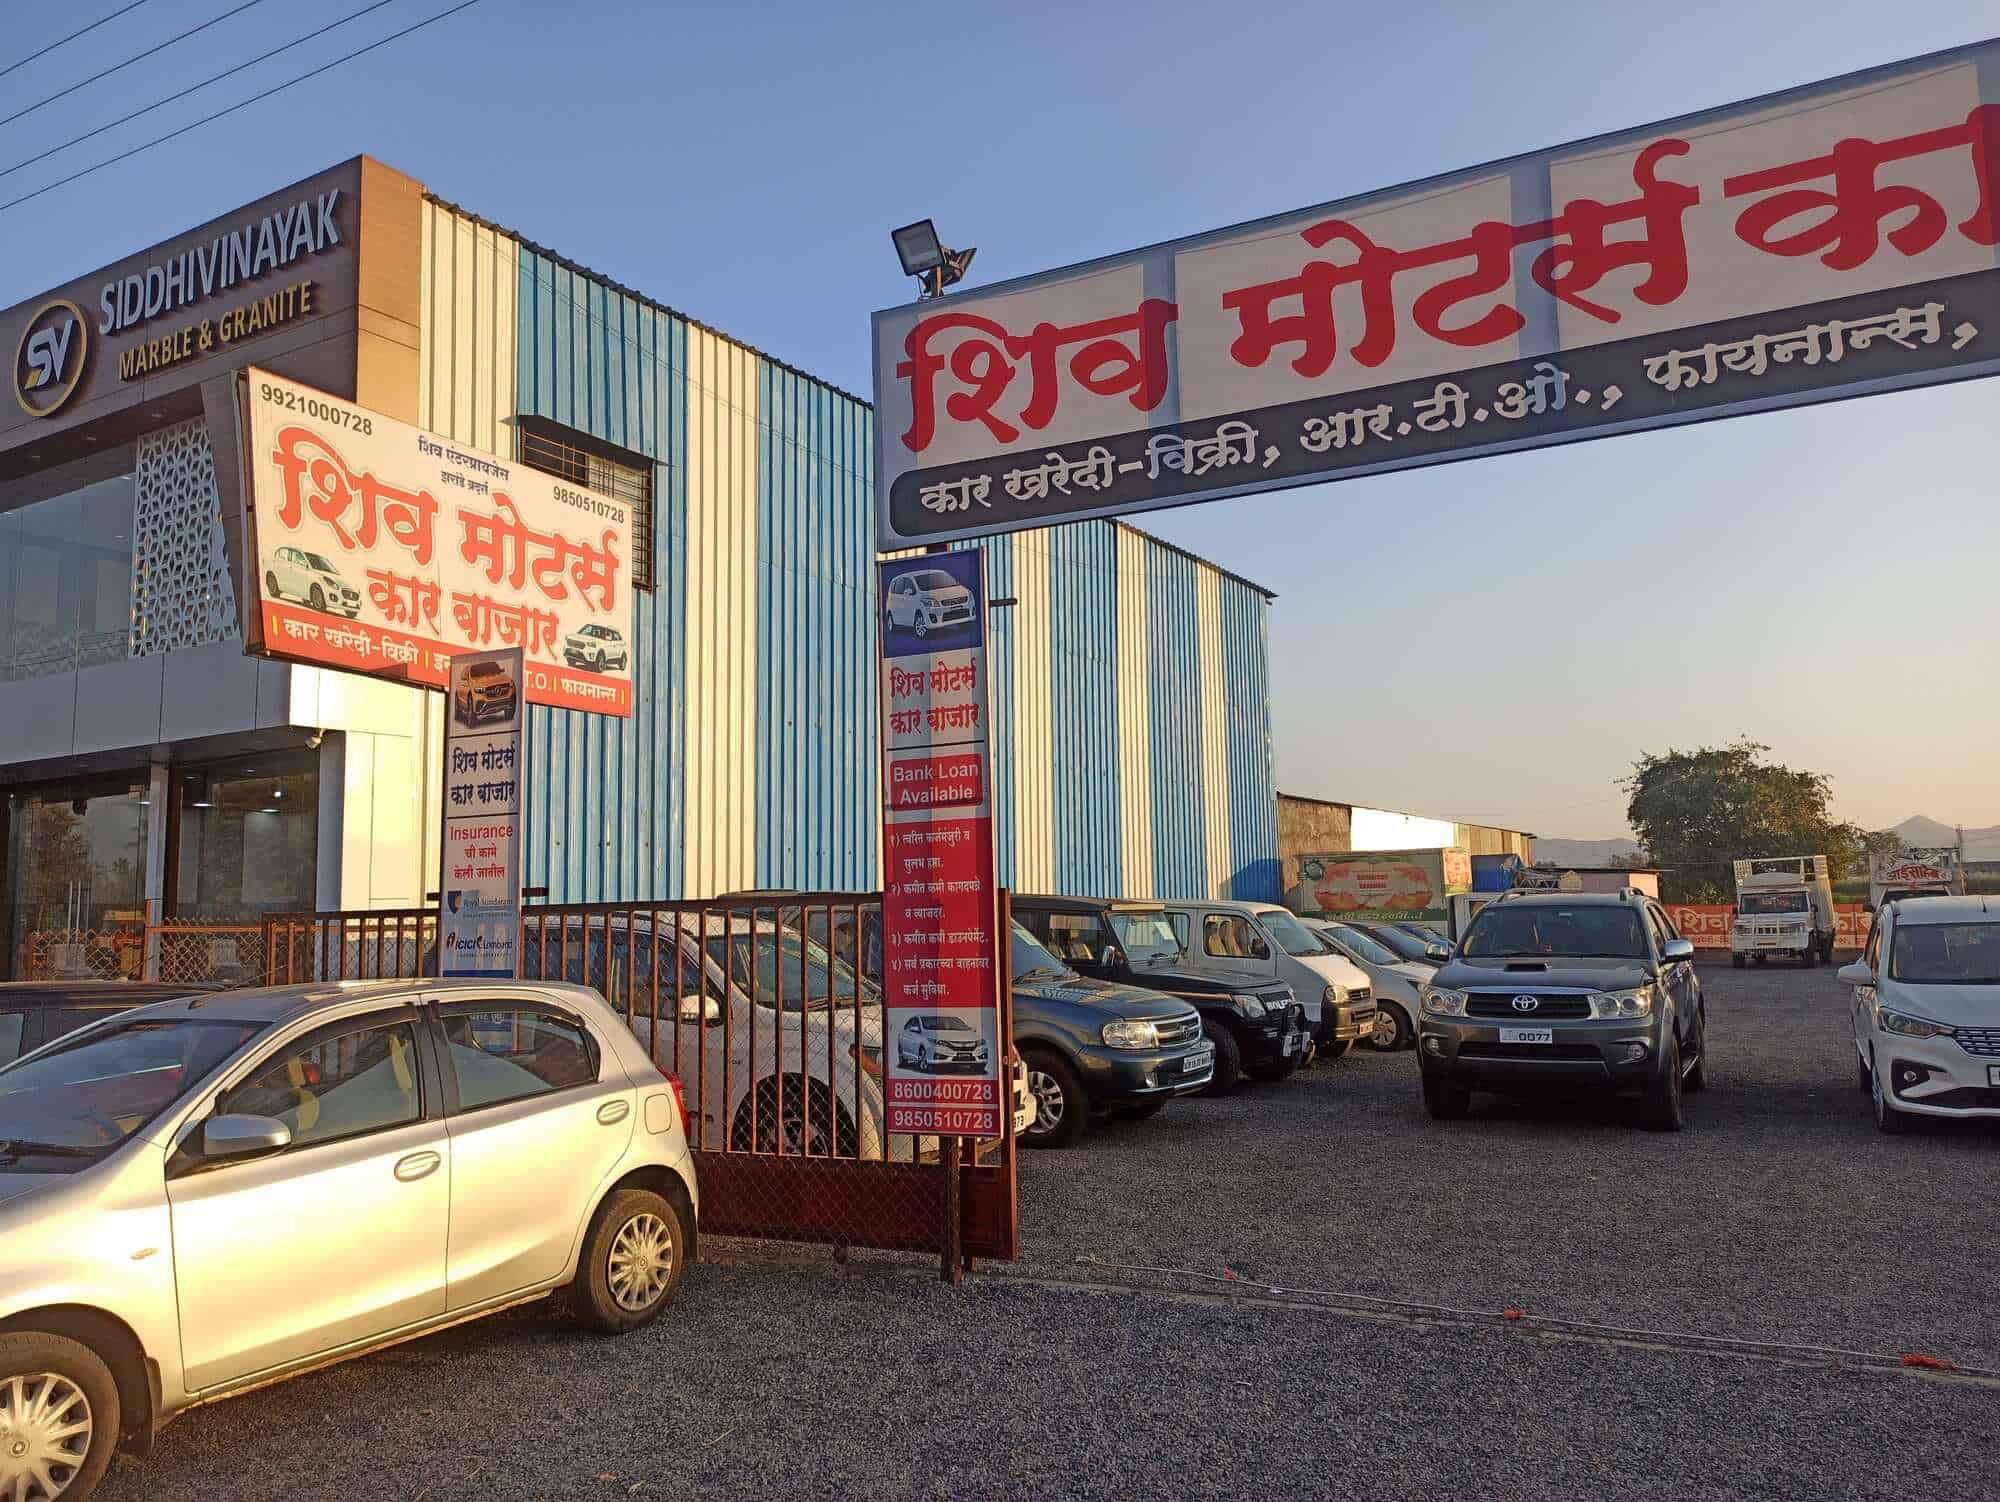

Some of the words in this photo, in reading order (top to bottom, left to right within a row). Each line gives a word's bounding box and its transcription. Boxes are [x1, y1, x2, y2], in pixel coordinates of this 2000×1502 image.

[99, 189, 341, 336] SIDDHIVINAYAK
[896, 299, 1178, 452] शिव
[1222, 139, 1700, 377] मोटर्स
[1723, 104, 2000, 271] का
[119, 326, 192, 381] MARBLE
[199, 319, 213, 351] &
[219, 280, 313, 343] GRANITE
[261, 384, 373, 436] 9921000728
[417, 436, 443, 460] शिव
[552, 486, 624, 524] 9850510728
[920, 474, 992, 513] कार
[273, 427, 438, 565] शिव
[457, 492, 619, 611] मोटर्स
[366, 568, 440, 635] कार
[452, 591, 559, 661] बाजार
[283, 618, 320, 648] कार
[889, 667, 925, 698] शिव
[930, 657, 977, 693] मोटर्स
[889, 709, 921, 734] कार
[927, 703, 980, 731] बाजार
[452, 747, 478, 774] शिव
[481, 741, 515, 770] मोटर्स
[893, 765, 933, 783] Bank
[938, 763, 979, 780] Loan
[450, 784, 474, 805] कार
[477, 780, 515, 804] बाजार
[900, 785, 974, 805] Available
[450, 824, 514, 841] Insurance
[894, 1082, 993, 1101] 8600400728
[894, 1110, 994, 1130] 9850510728
